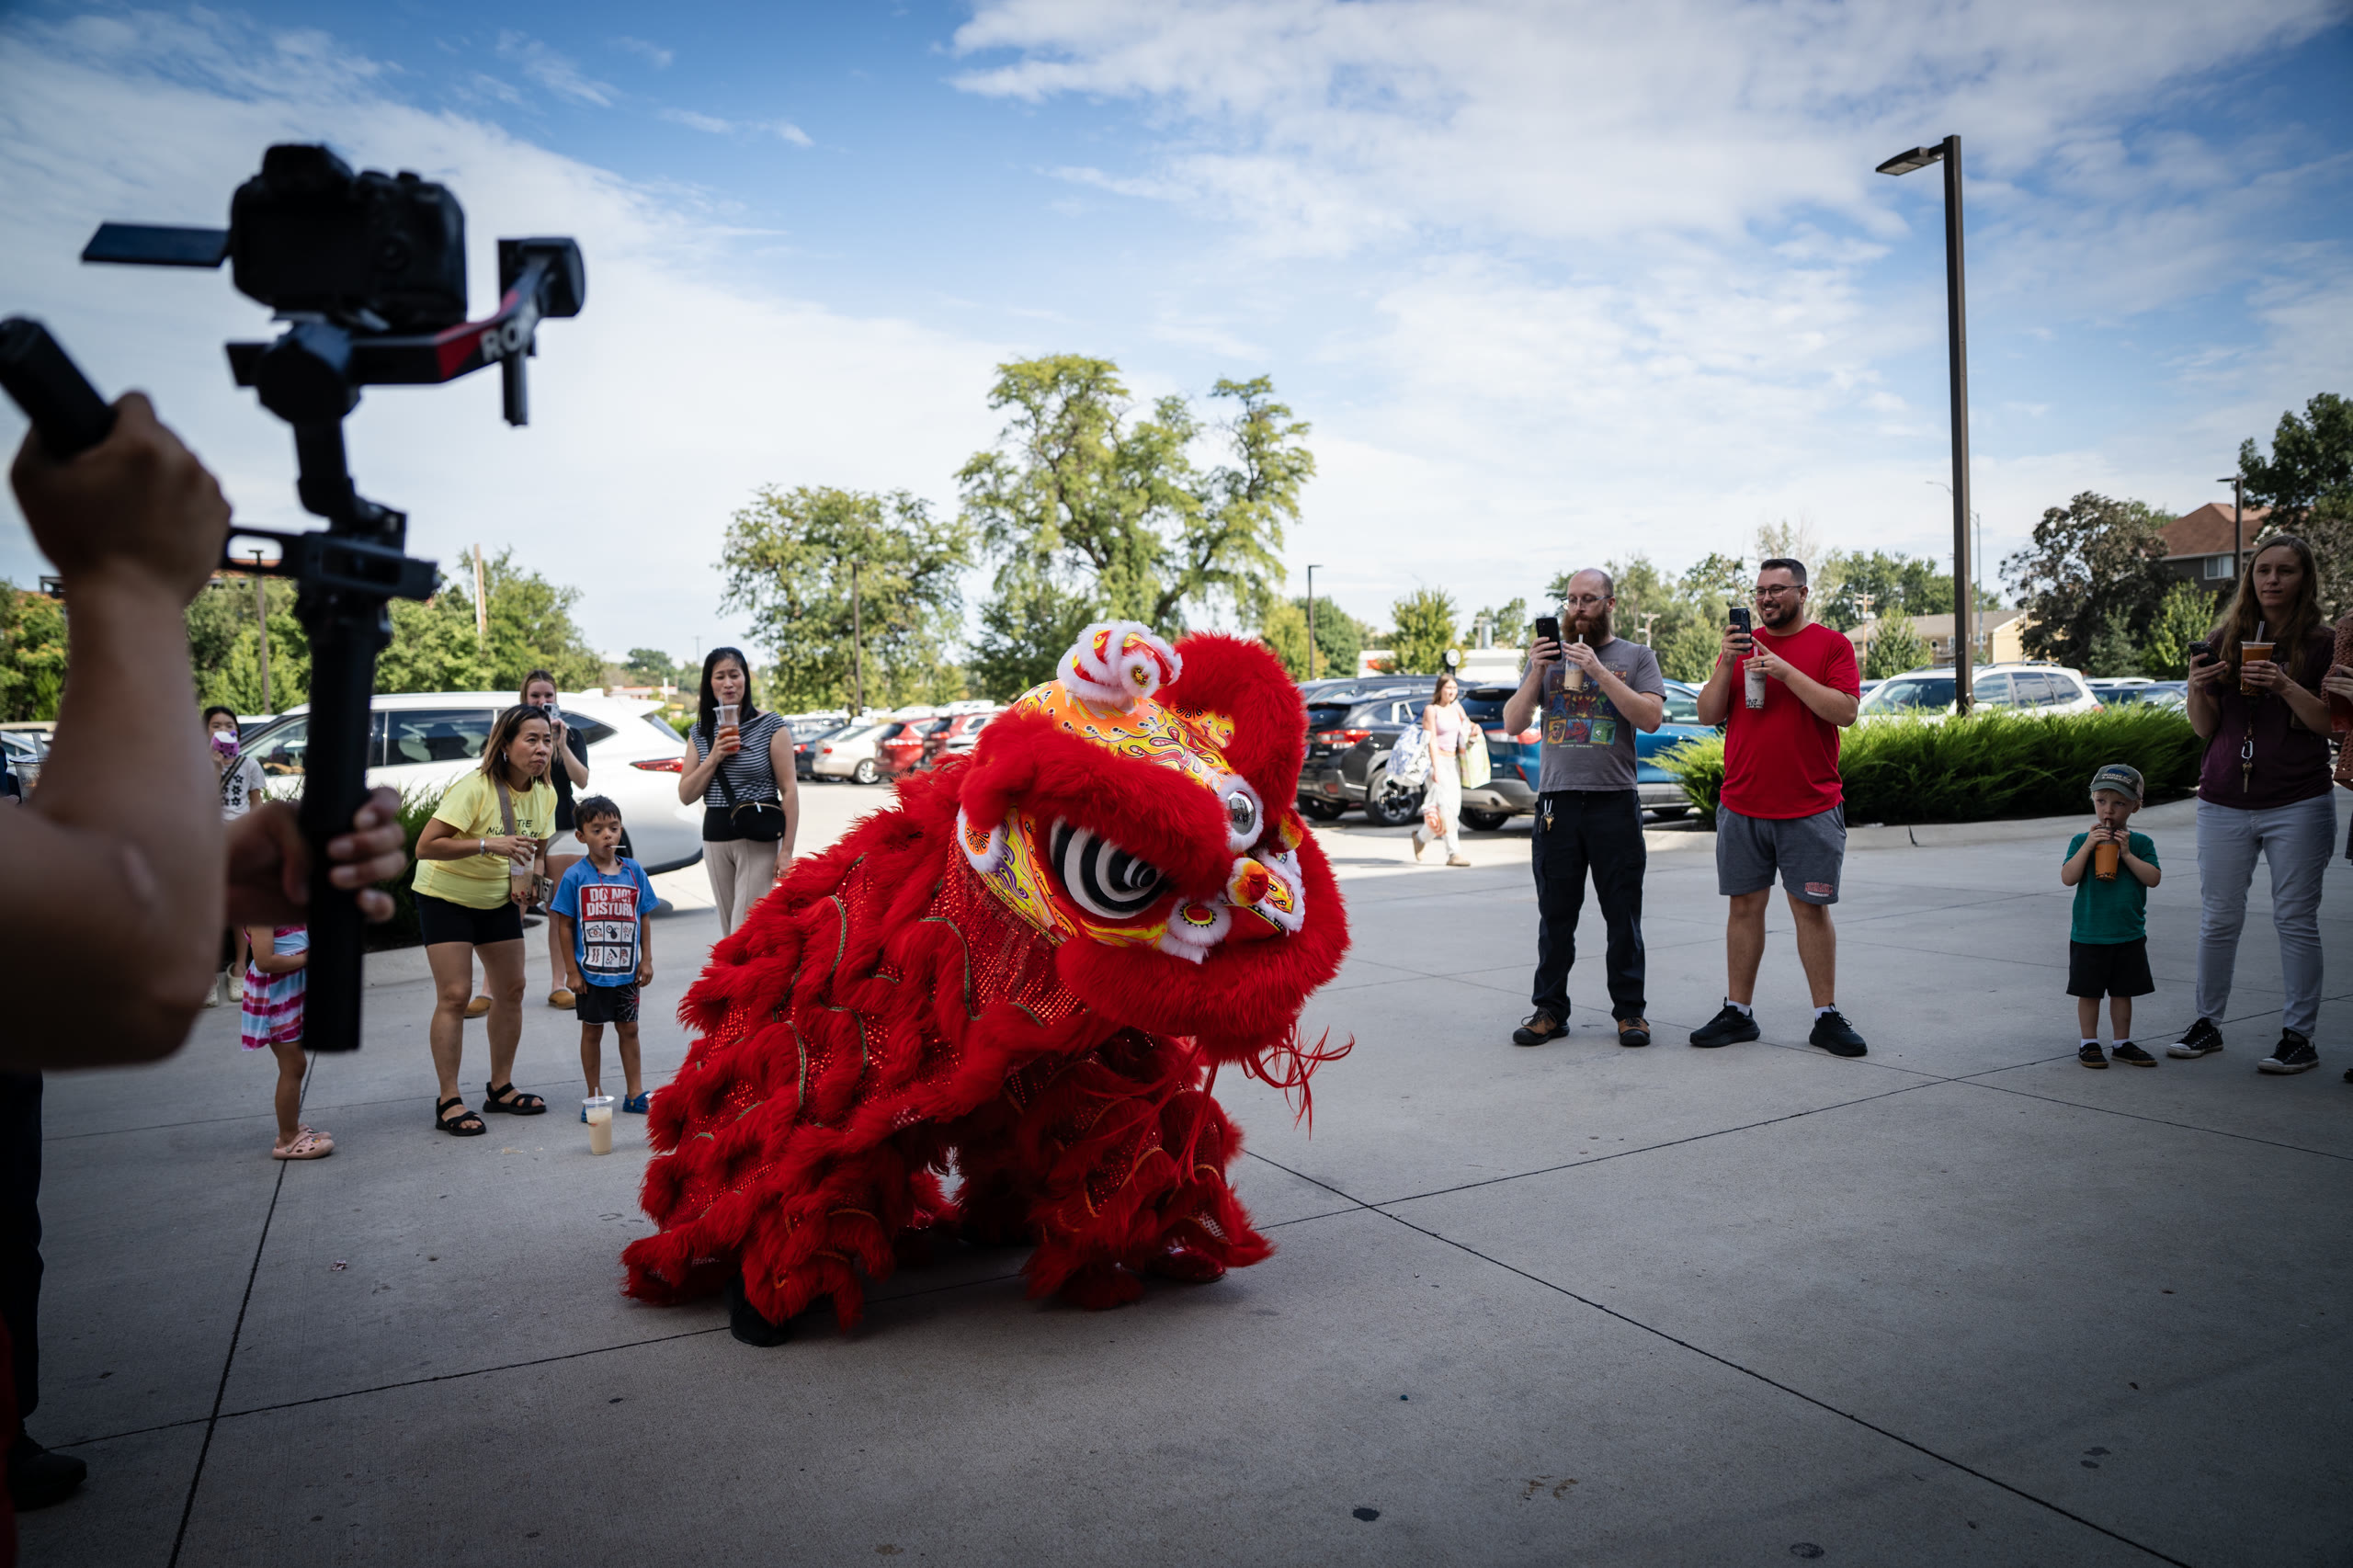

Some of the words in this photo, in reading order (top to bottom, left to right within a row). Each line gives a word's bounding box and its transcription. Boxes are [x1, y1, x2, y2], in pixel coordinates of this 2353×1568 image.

[589, 888, 608, 903] DO
[611, 888, 631, 903] NOT
[586, 902, 634, 917] DISTURB
